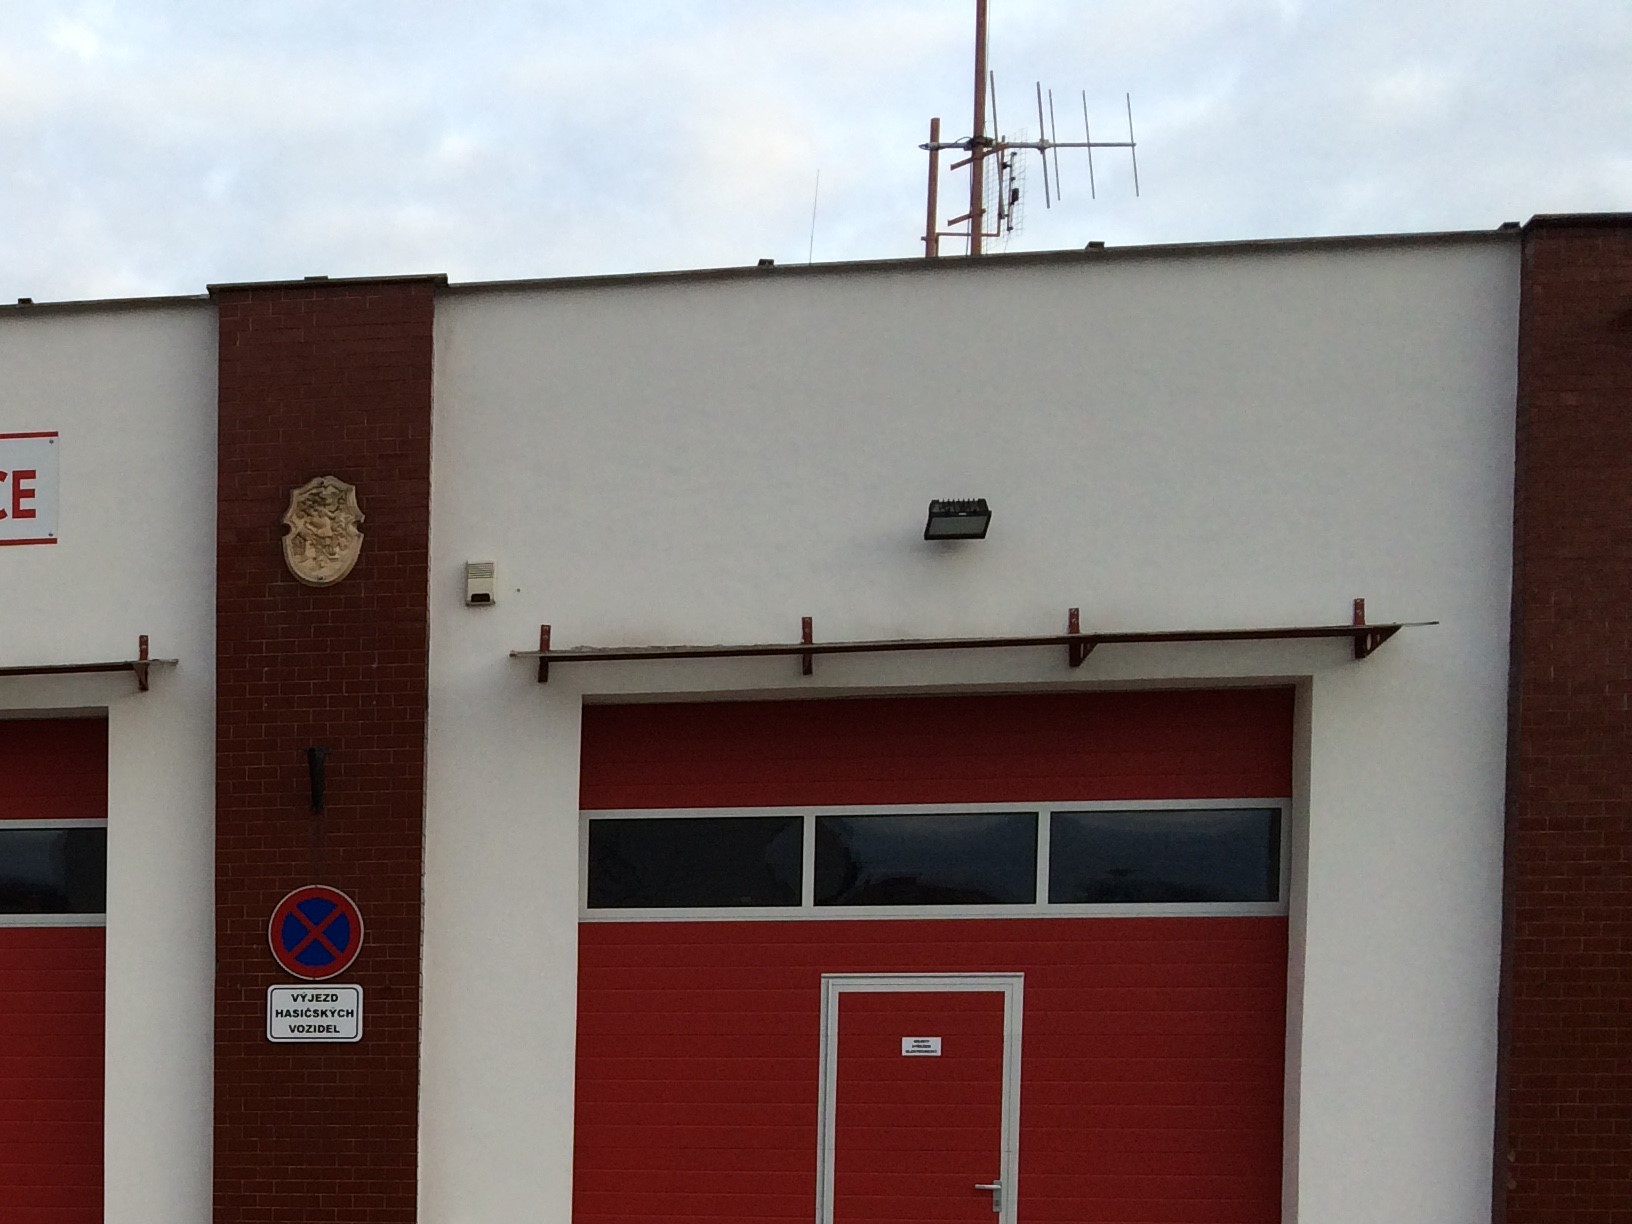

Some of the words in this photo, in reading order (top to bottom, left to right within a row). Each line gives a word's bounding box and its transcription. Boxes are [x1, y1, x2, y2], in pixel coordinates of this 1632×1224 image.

[290, 991, 339, 1003] VÝJEZD
[275, 1007, 354, 1018] HASIČSKÝCH
[288, 1024, 341, 1034] VOZIDEL
